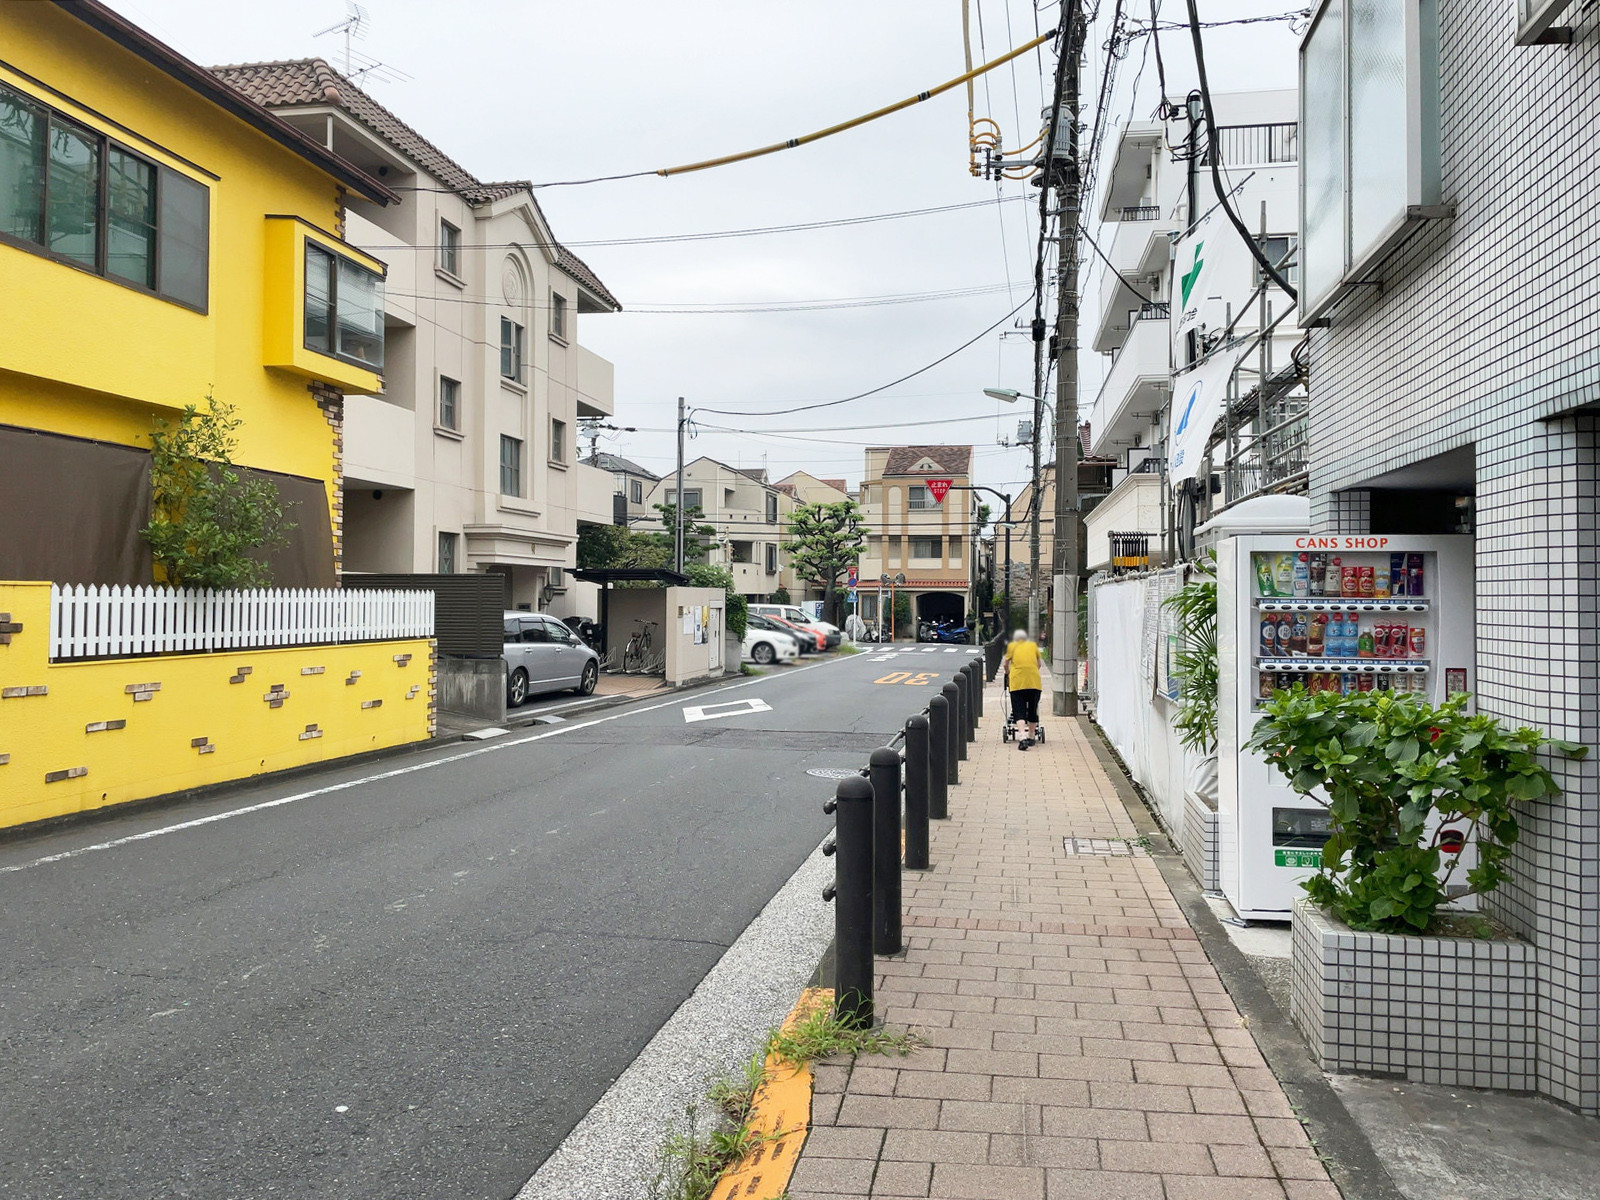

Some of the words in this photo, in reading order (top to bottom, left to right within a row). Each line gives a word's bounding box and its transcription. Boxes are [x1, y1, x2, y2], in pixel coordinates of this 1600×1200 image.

[1295, 537, 1338, 548] CANS
[1345, 537, 1389, 548] SHOP
[873, 672, 940, 686] 30
